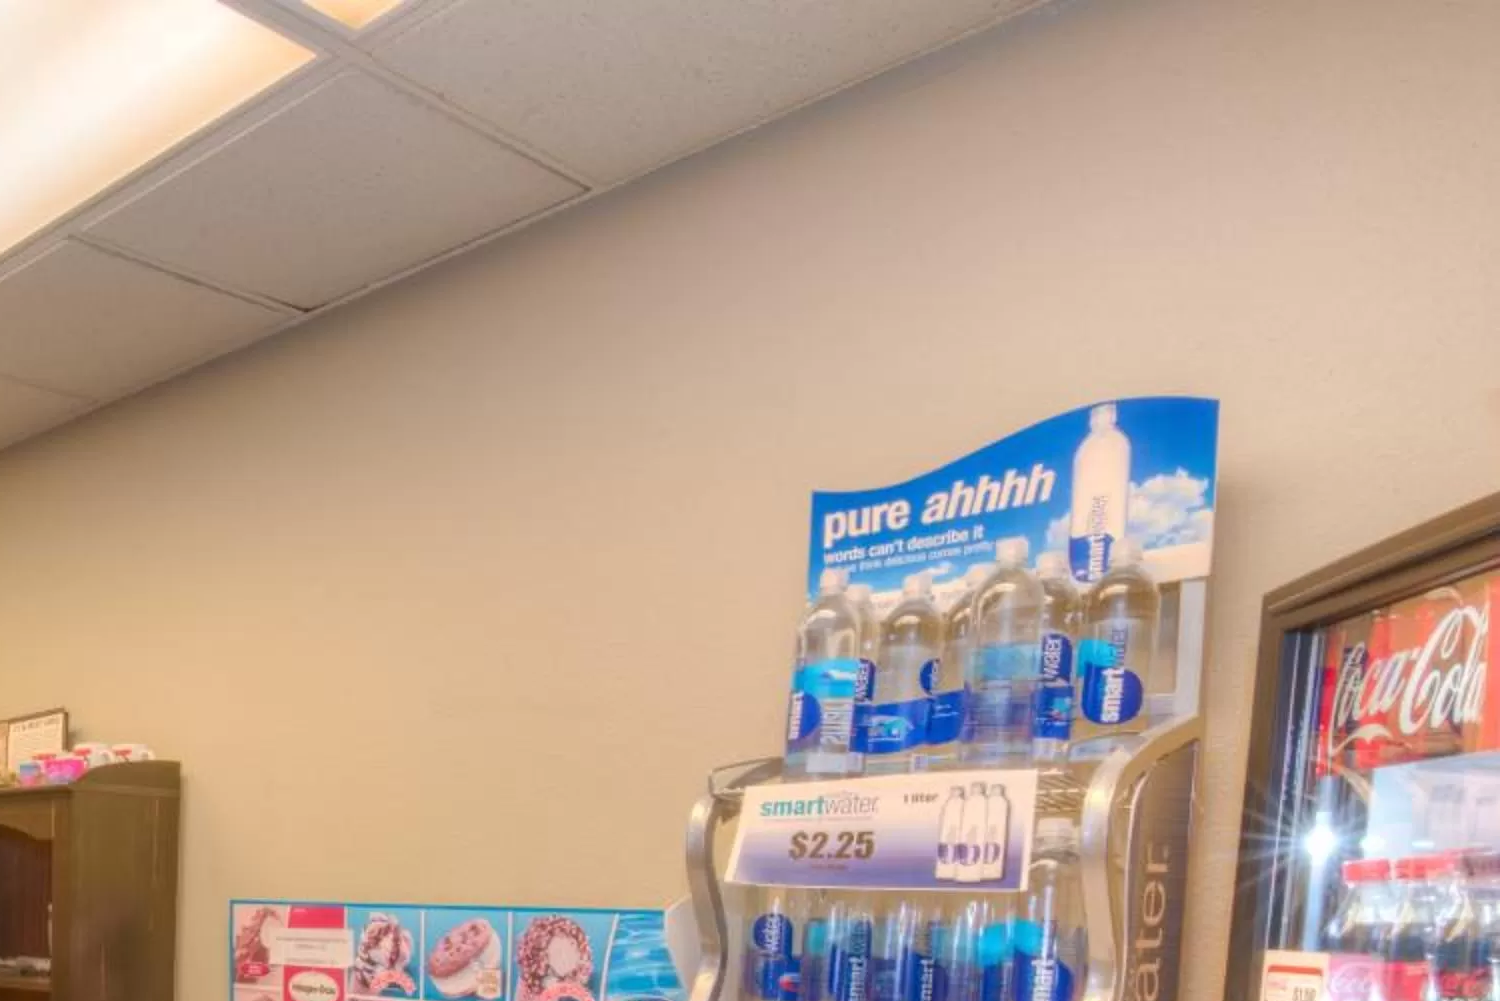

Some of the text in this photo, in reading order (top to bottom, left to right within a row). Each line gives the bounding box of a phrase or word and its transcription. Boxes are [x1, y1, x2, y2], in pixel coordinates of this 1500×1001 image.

[824, 463, 1056, 548] pure ahhhh
[824, 524, 984, 563] words can't describe it
[1329, 604, 1488, 760] Coca-Cola
[759, 792, 880, 818] smartwater
[788, 830, 876, 861] $2.25
